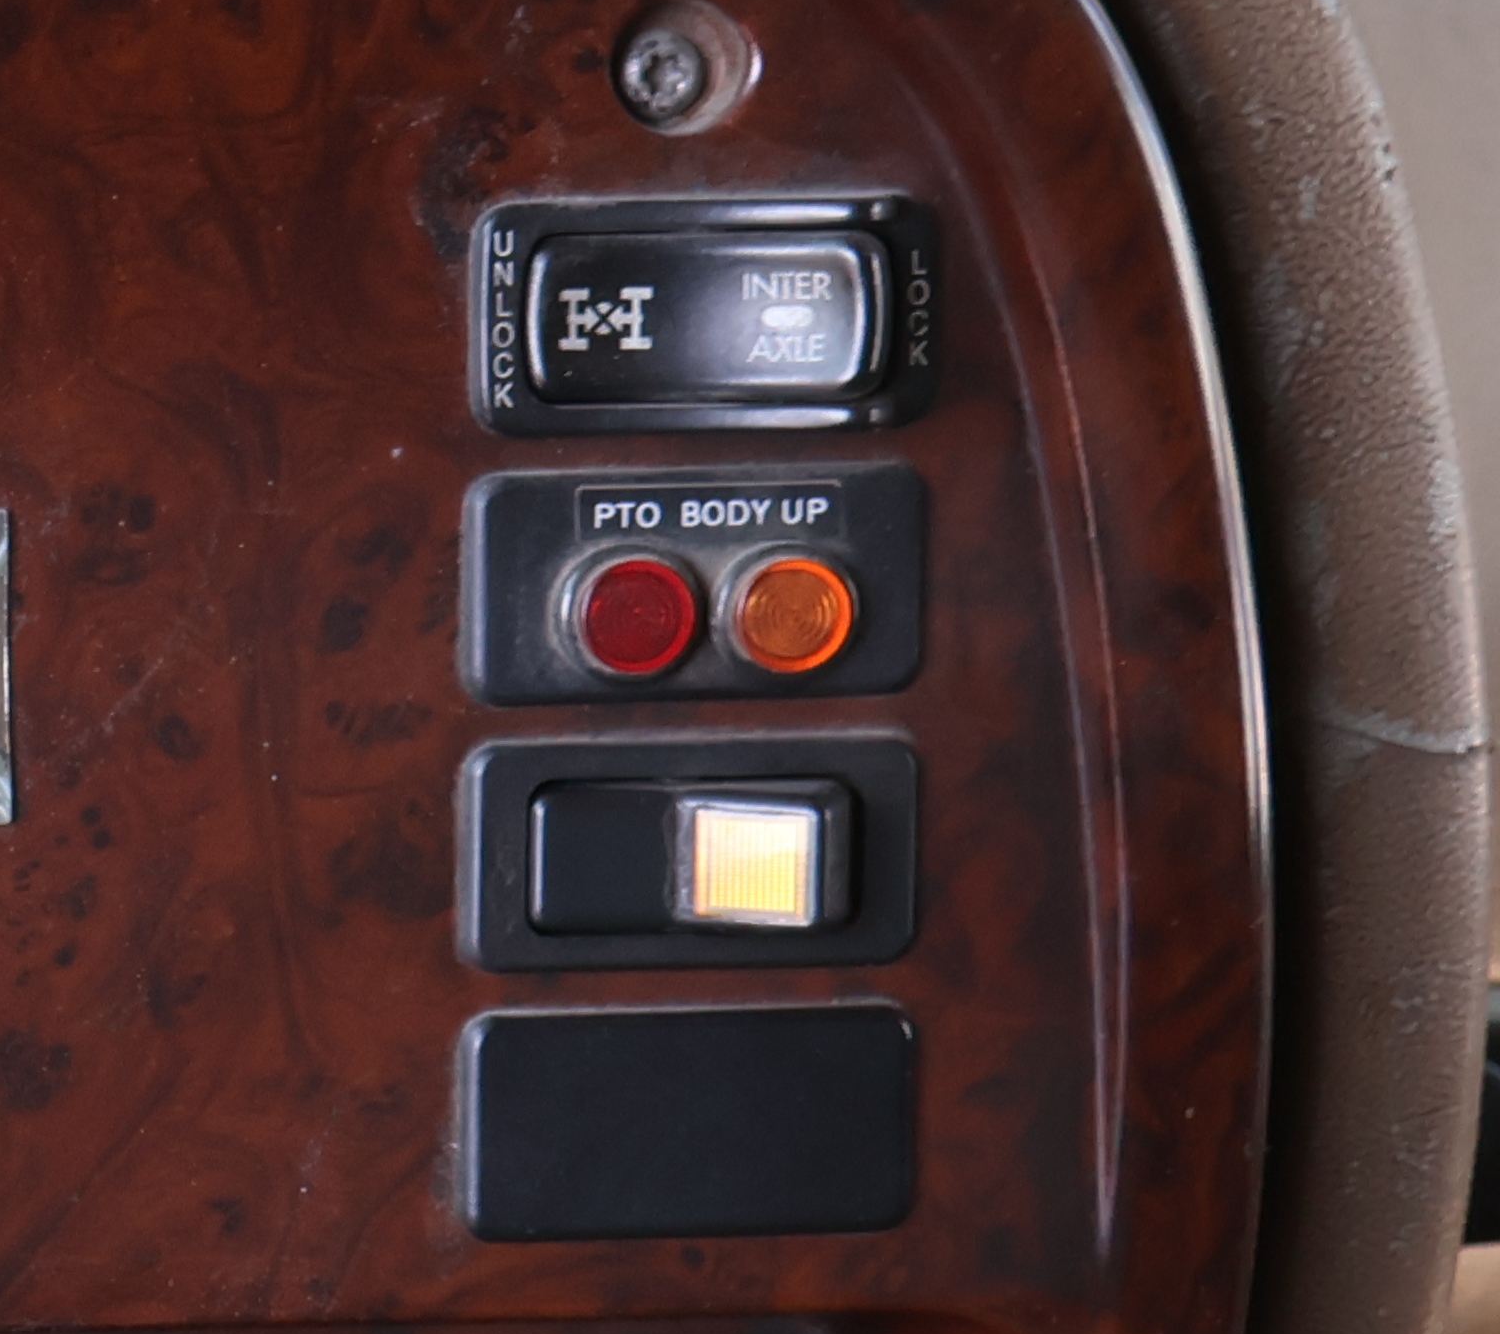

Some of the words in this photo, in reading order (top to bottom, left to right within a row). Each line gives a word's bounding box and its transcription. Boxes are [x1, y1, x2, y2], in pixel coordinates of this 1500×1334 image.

[741, 270, 832, 301] INTER
[492, 229, 516, 409] UNLOCK
[906, 248, 932, 367] LOCK
[745, 332, 826, 364] AXLE
[592, 500, 662, 530] PTO
[679, 498, 772, 528] BODY
[781, 496, 830, 524] UP
